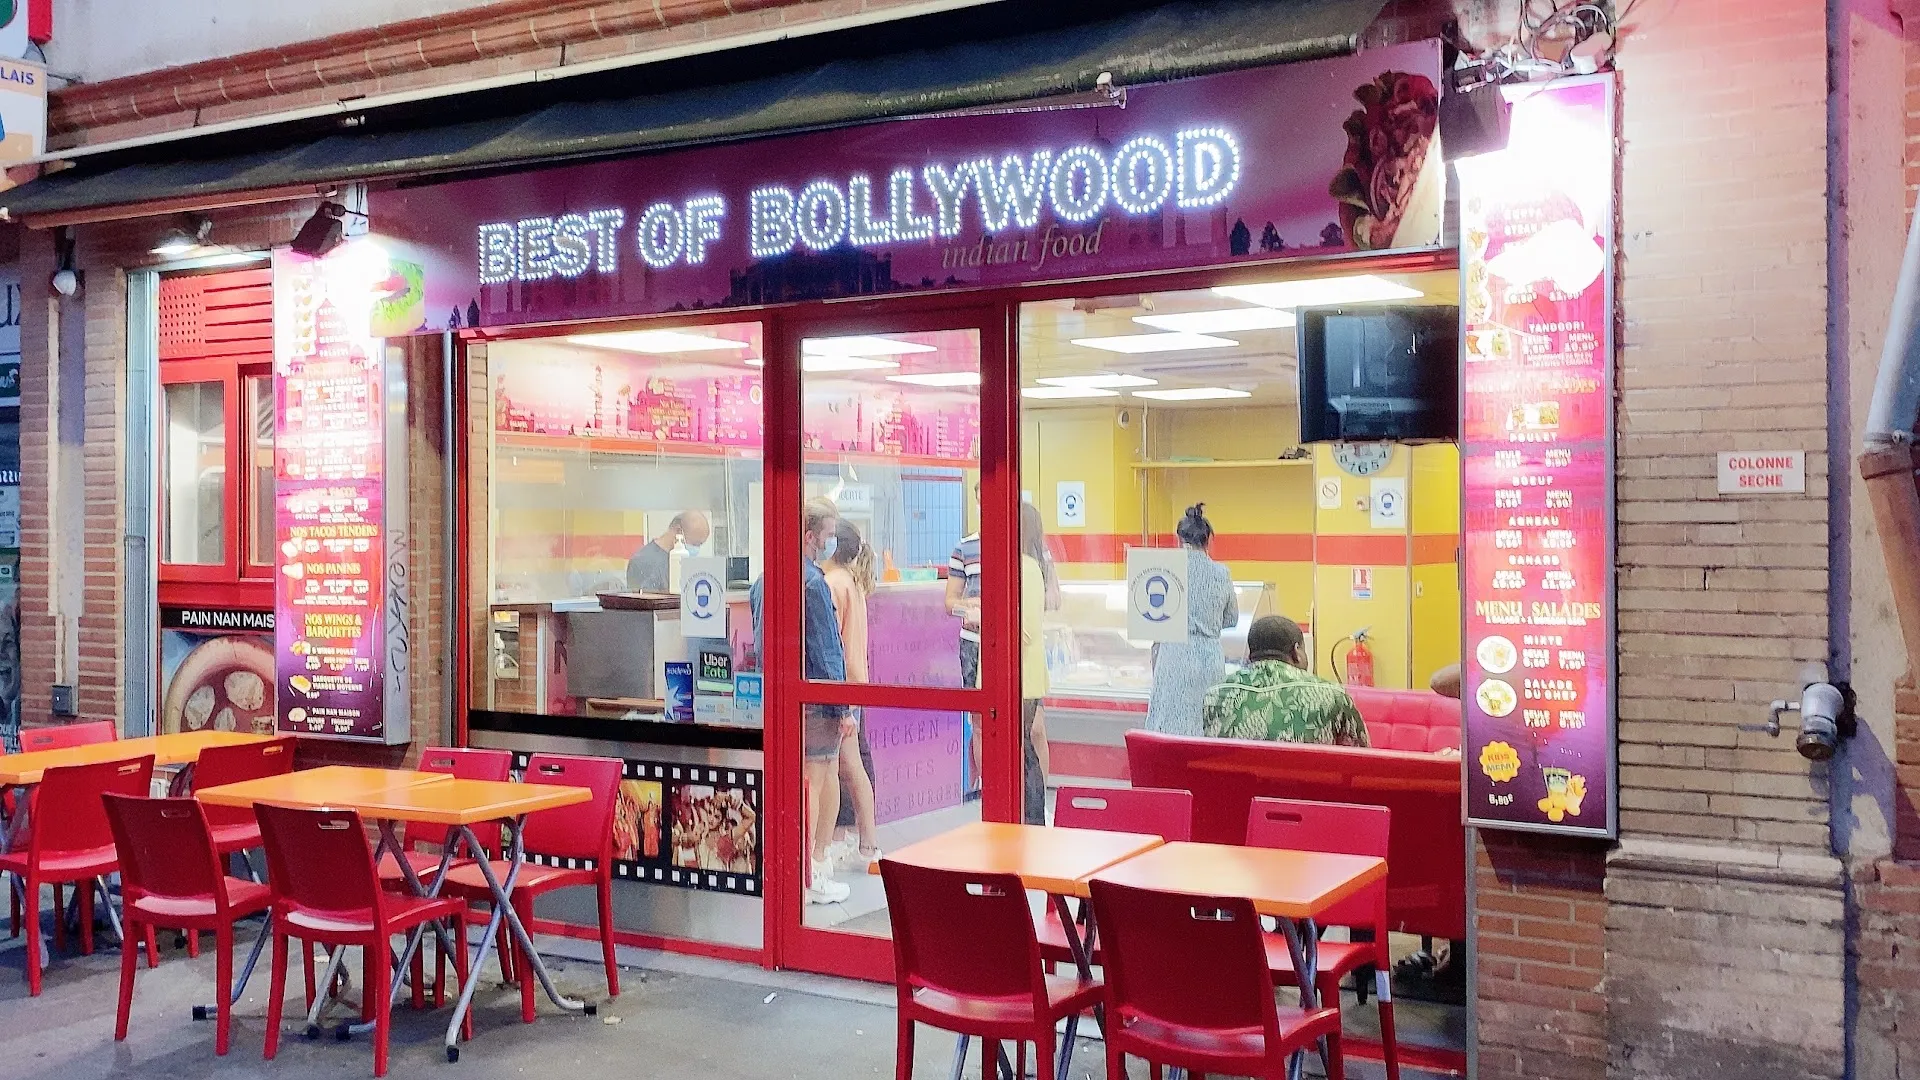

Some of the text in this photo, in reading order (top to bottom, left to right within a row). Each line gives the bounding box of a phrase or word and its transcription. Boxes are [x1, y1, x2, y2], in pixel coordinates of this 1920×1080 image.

[478, 126, 1241, 284] BEST OF BOLLYWOOD
[942, 219, 1110, 270] indian food
[1528, 321, 1584, 333] TANDOORI
[1569, 333, 1594, 342] MENU
[1509, 432, 1557, 443] POULET
[1545, 449, 1571, 459] MENU
[1728, 457, 1794, 470] COLONNE
[1739, 474, 1784, 487] SECHE
[1509, 516, 1559, 527] AGNEAU
[290, 524, 378, 537] NOS TACOS TENDERS
[1509, 555, 1560, 566] CANARD
[306, 563, 360, 574] NOS PANINIS
[1476, 600, 1601, 619] MENU SALADES
[182, 611, 275, 628] PAIN NAN MAIS
[305, 614, 362, 626] NOS WINGS &
[306, 626, 361, 638] BARQUETTES
[1523, 635, 1563, 646] MIXTE
[703, 653, 728, 667] Uber
[703, 666, 727, 680] Eats
[1524, 679, 1573, 690] SALADE
[1525, 688, 1577, 701] DU CHEF
[1487, 754, 1510, 763] KIDS
[1486, 763, 1515, 772] MENU
